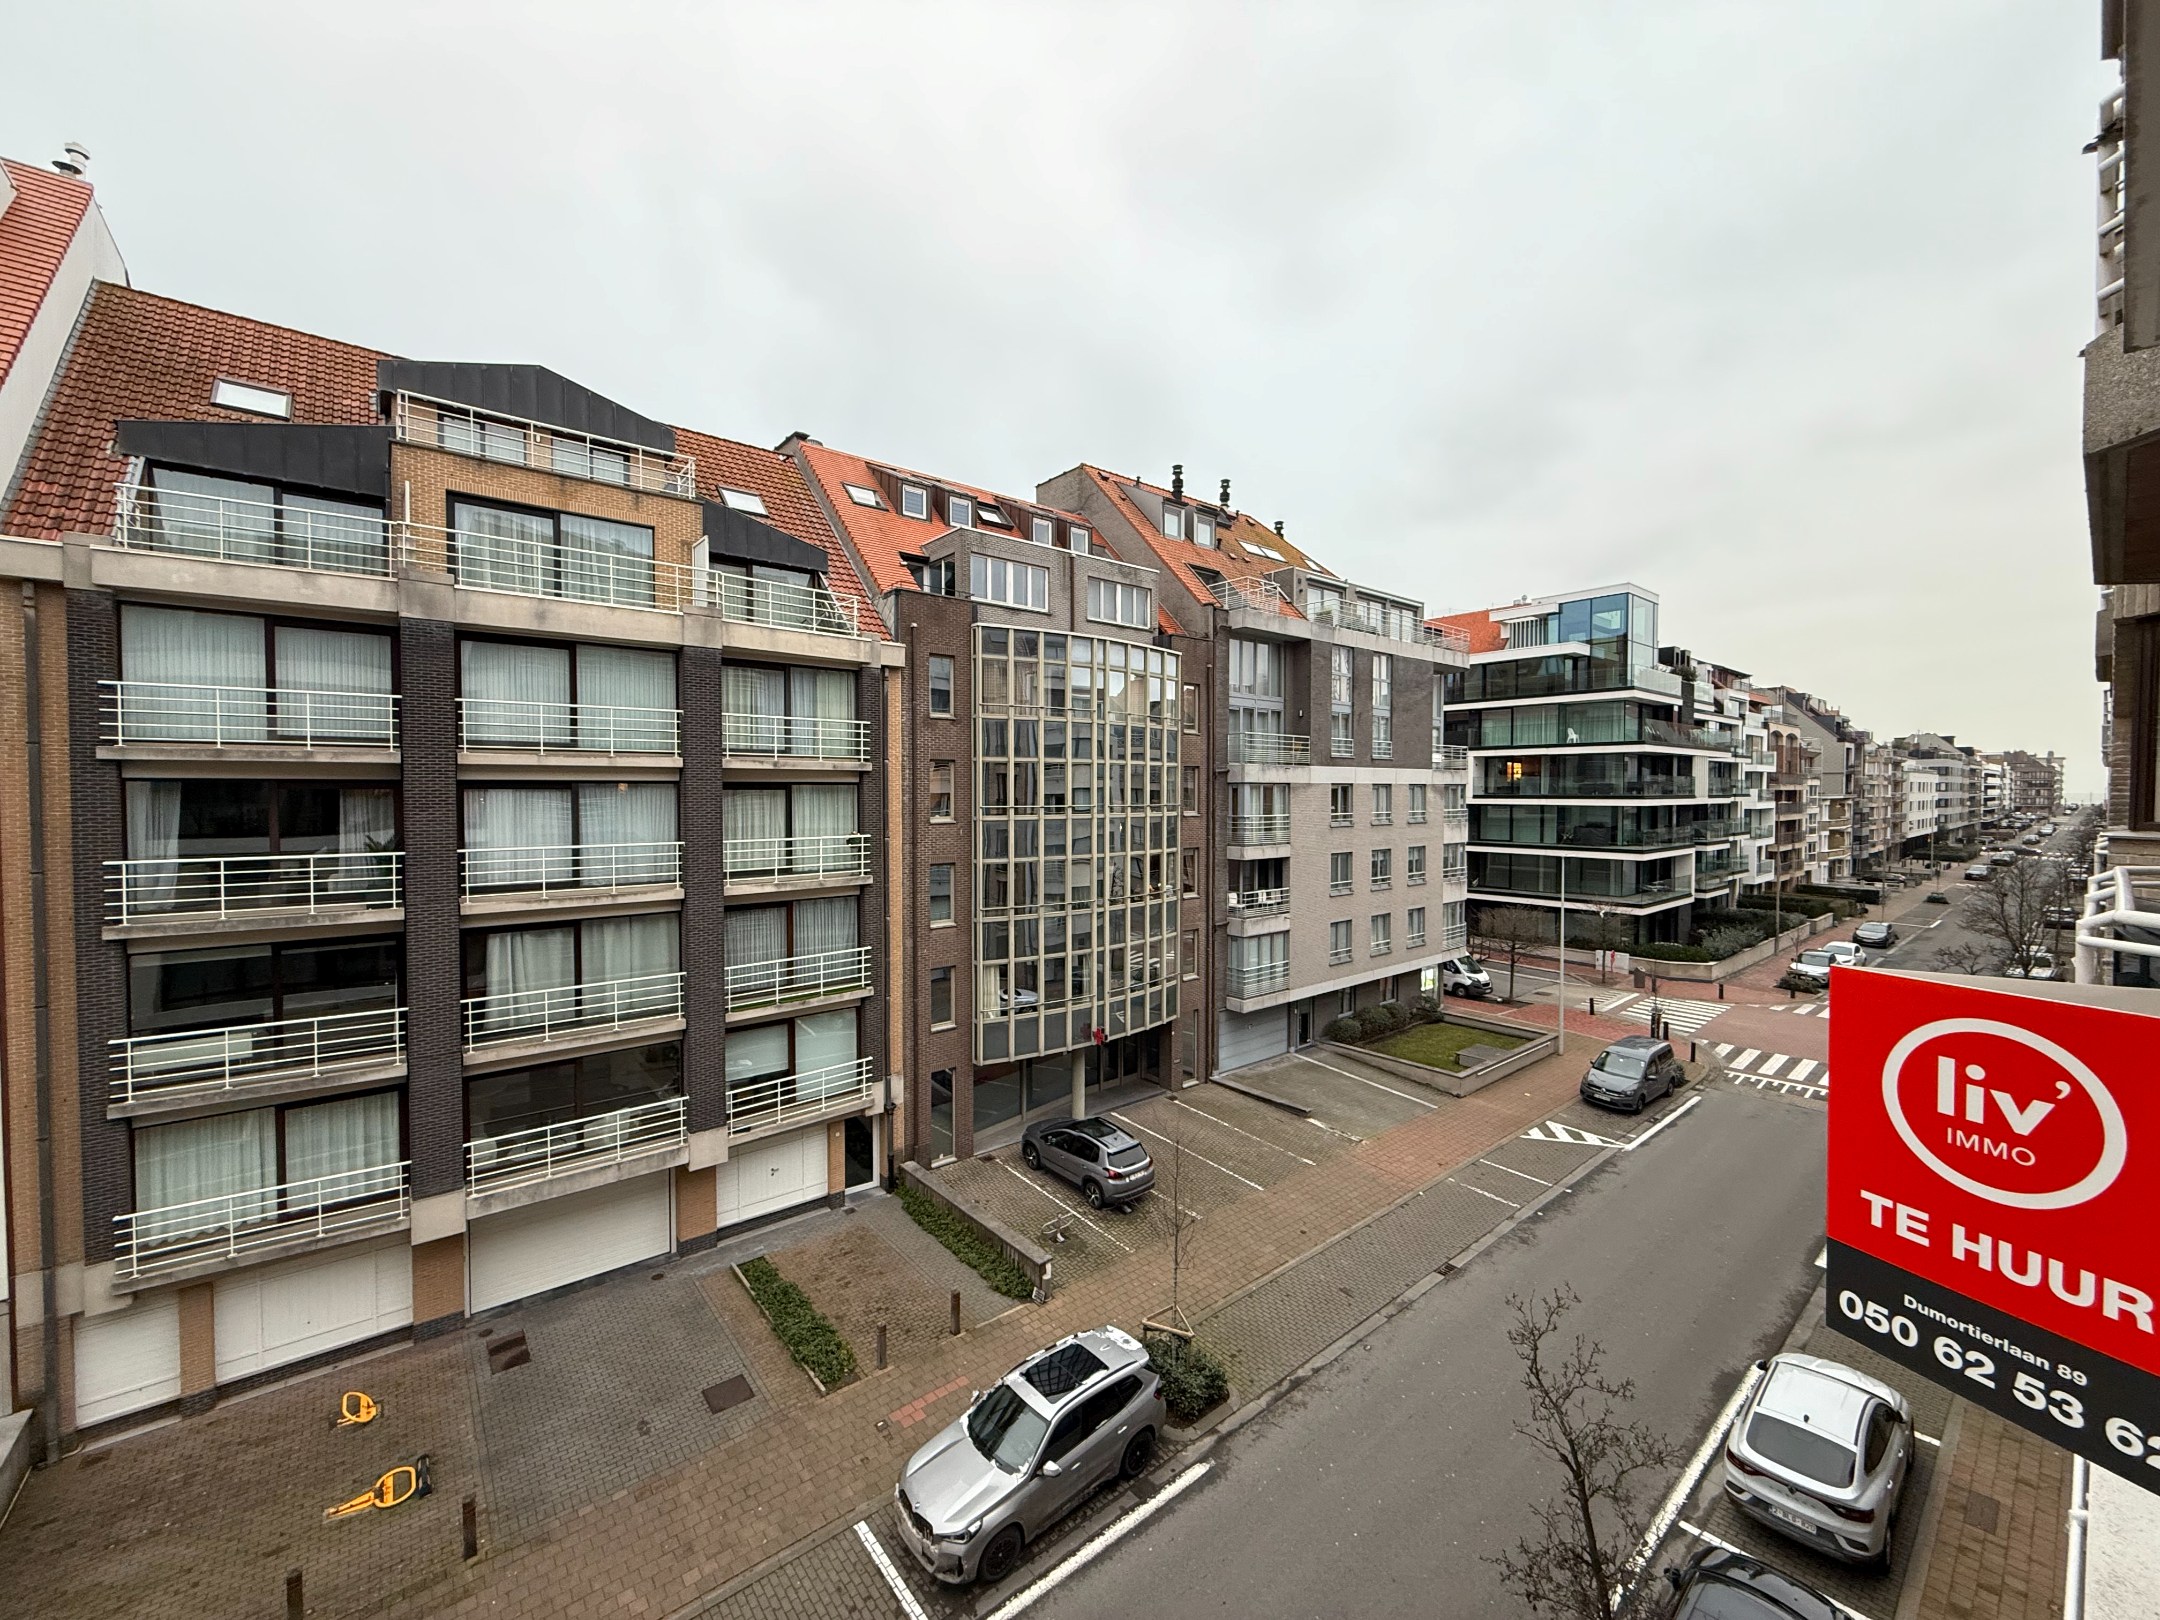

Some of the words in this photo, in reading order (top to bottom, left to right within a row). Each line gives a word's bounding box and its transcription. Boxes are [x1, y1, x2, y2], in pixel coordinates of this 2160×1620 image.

[1947, 1127, 2036, 1166] IMMO
[1860, 1189, 1930, 1247] TE
[1952, 1223, 2155, 1334] HUUR
[1839, 1290, 1919, 1348] 050
[1933, 1336, 1996, 1390] 62
[2012, 1371, 2085, 1429] 53
[1903, 1294, 2050, 1371] Dumortierlaan
[2057, 1364, 2088, 1387] 89
